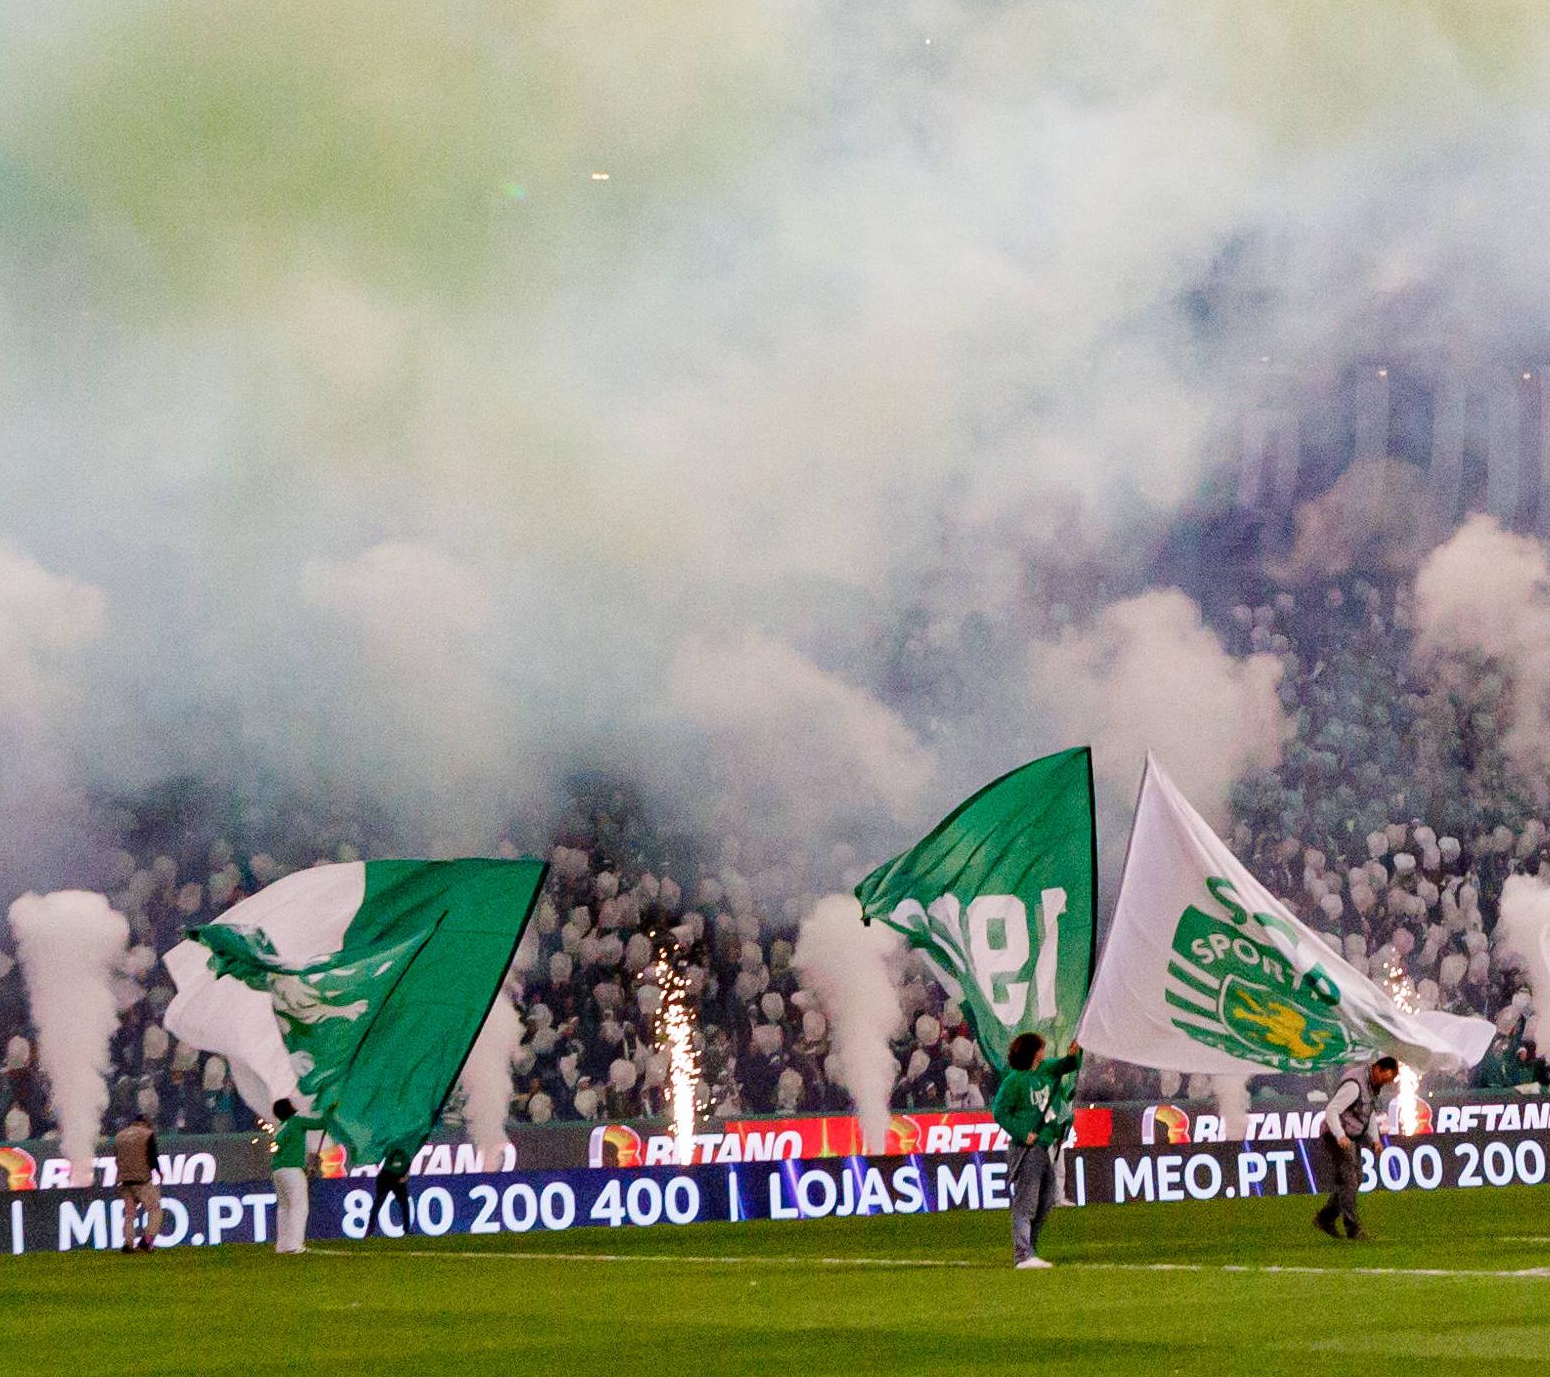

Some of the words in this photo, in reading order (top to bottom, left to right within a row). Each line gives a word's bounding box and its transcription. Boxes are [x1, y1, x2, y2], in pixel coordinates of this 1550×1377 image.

[1113, 1150, 1295, 1204] MEO.PT
[1453, 1139, 1547, 1188] 200
[468, 1182, 577, 1235] 200
[588, 1175, 701, 1229] 400
[768, 1164, 924, 1220] LOJAS
